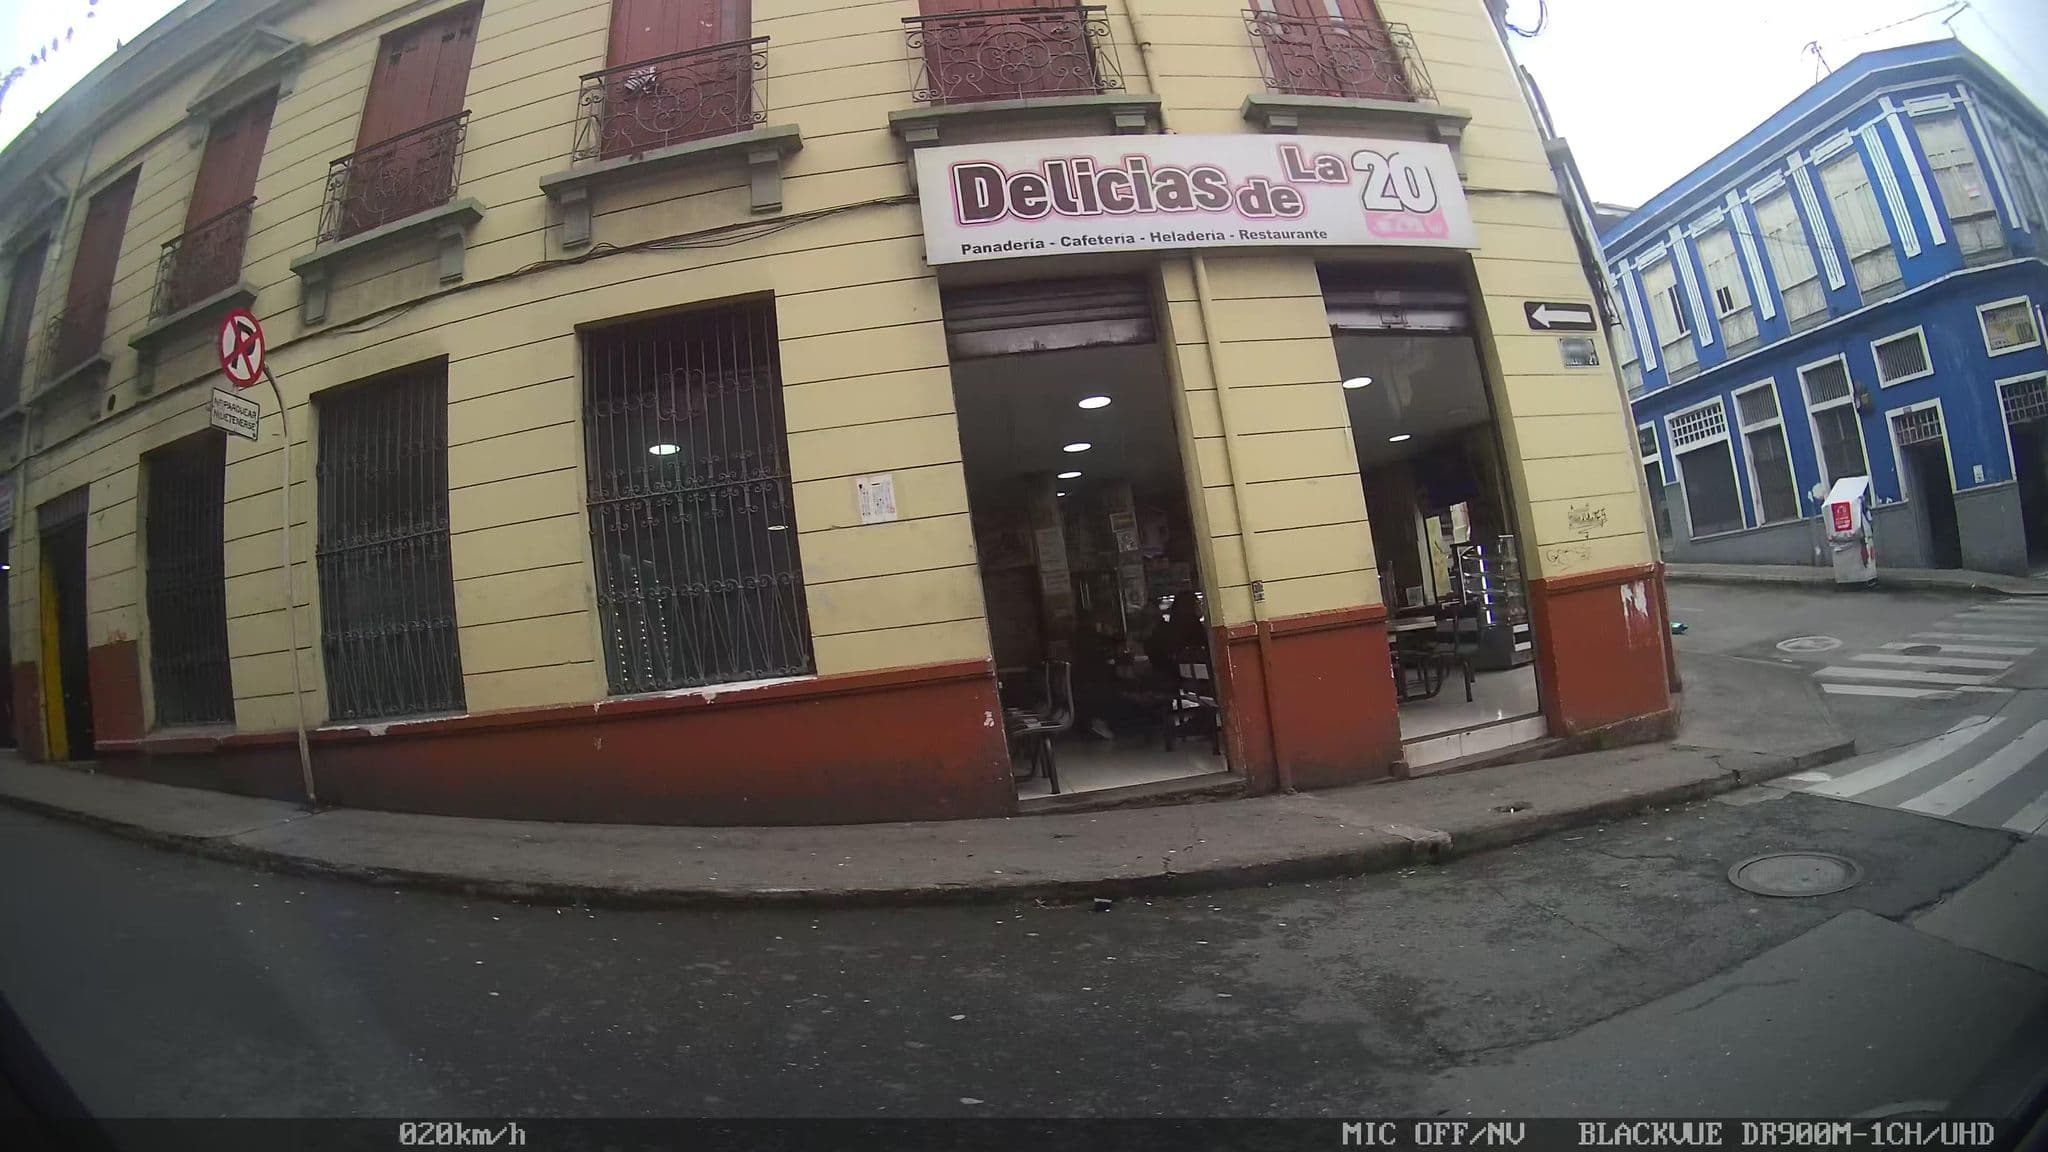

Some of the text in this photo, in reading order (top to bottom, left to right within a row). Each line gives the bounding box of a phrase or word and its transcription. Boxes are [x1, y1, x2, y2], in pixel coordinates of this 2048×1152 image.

[952, 145, 1437, 224] Delicias de La 20
[1239, 228, 1328, 241] Restaurante
